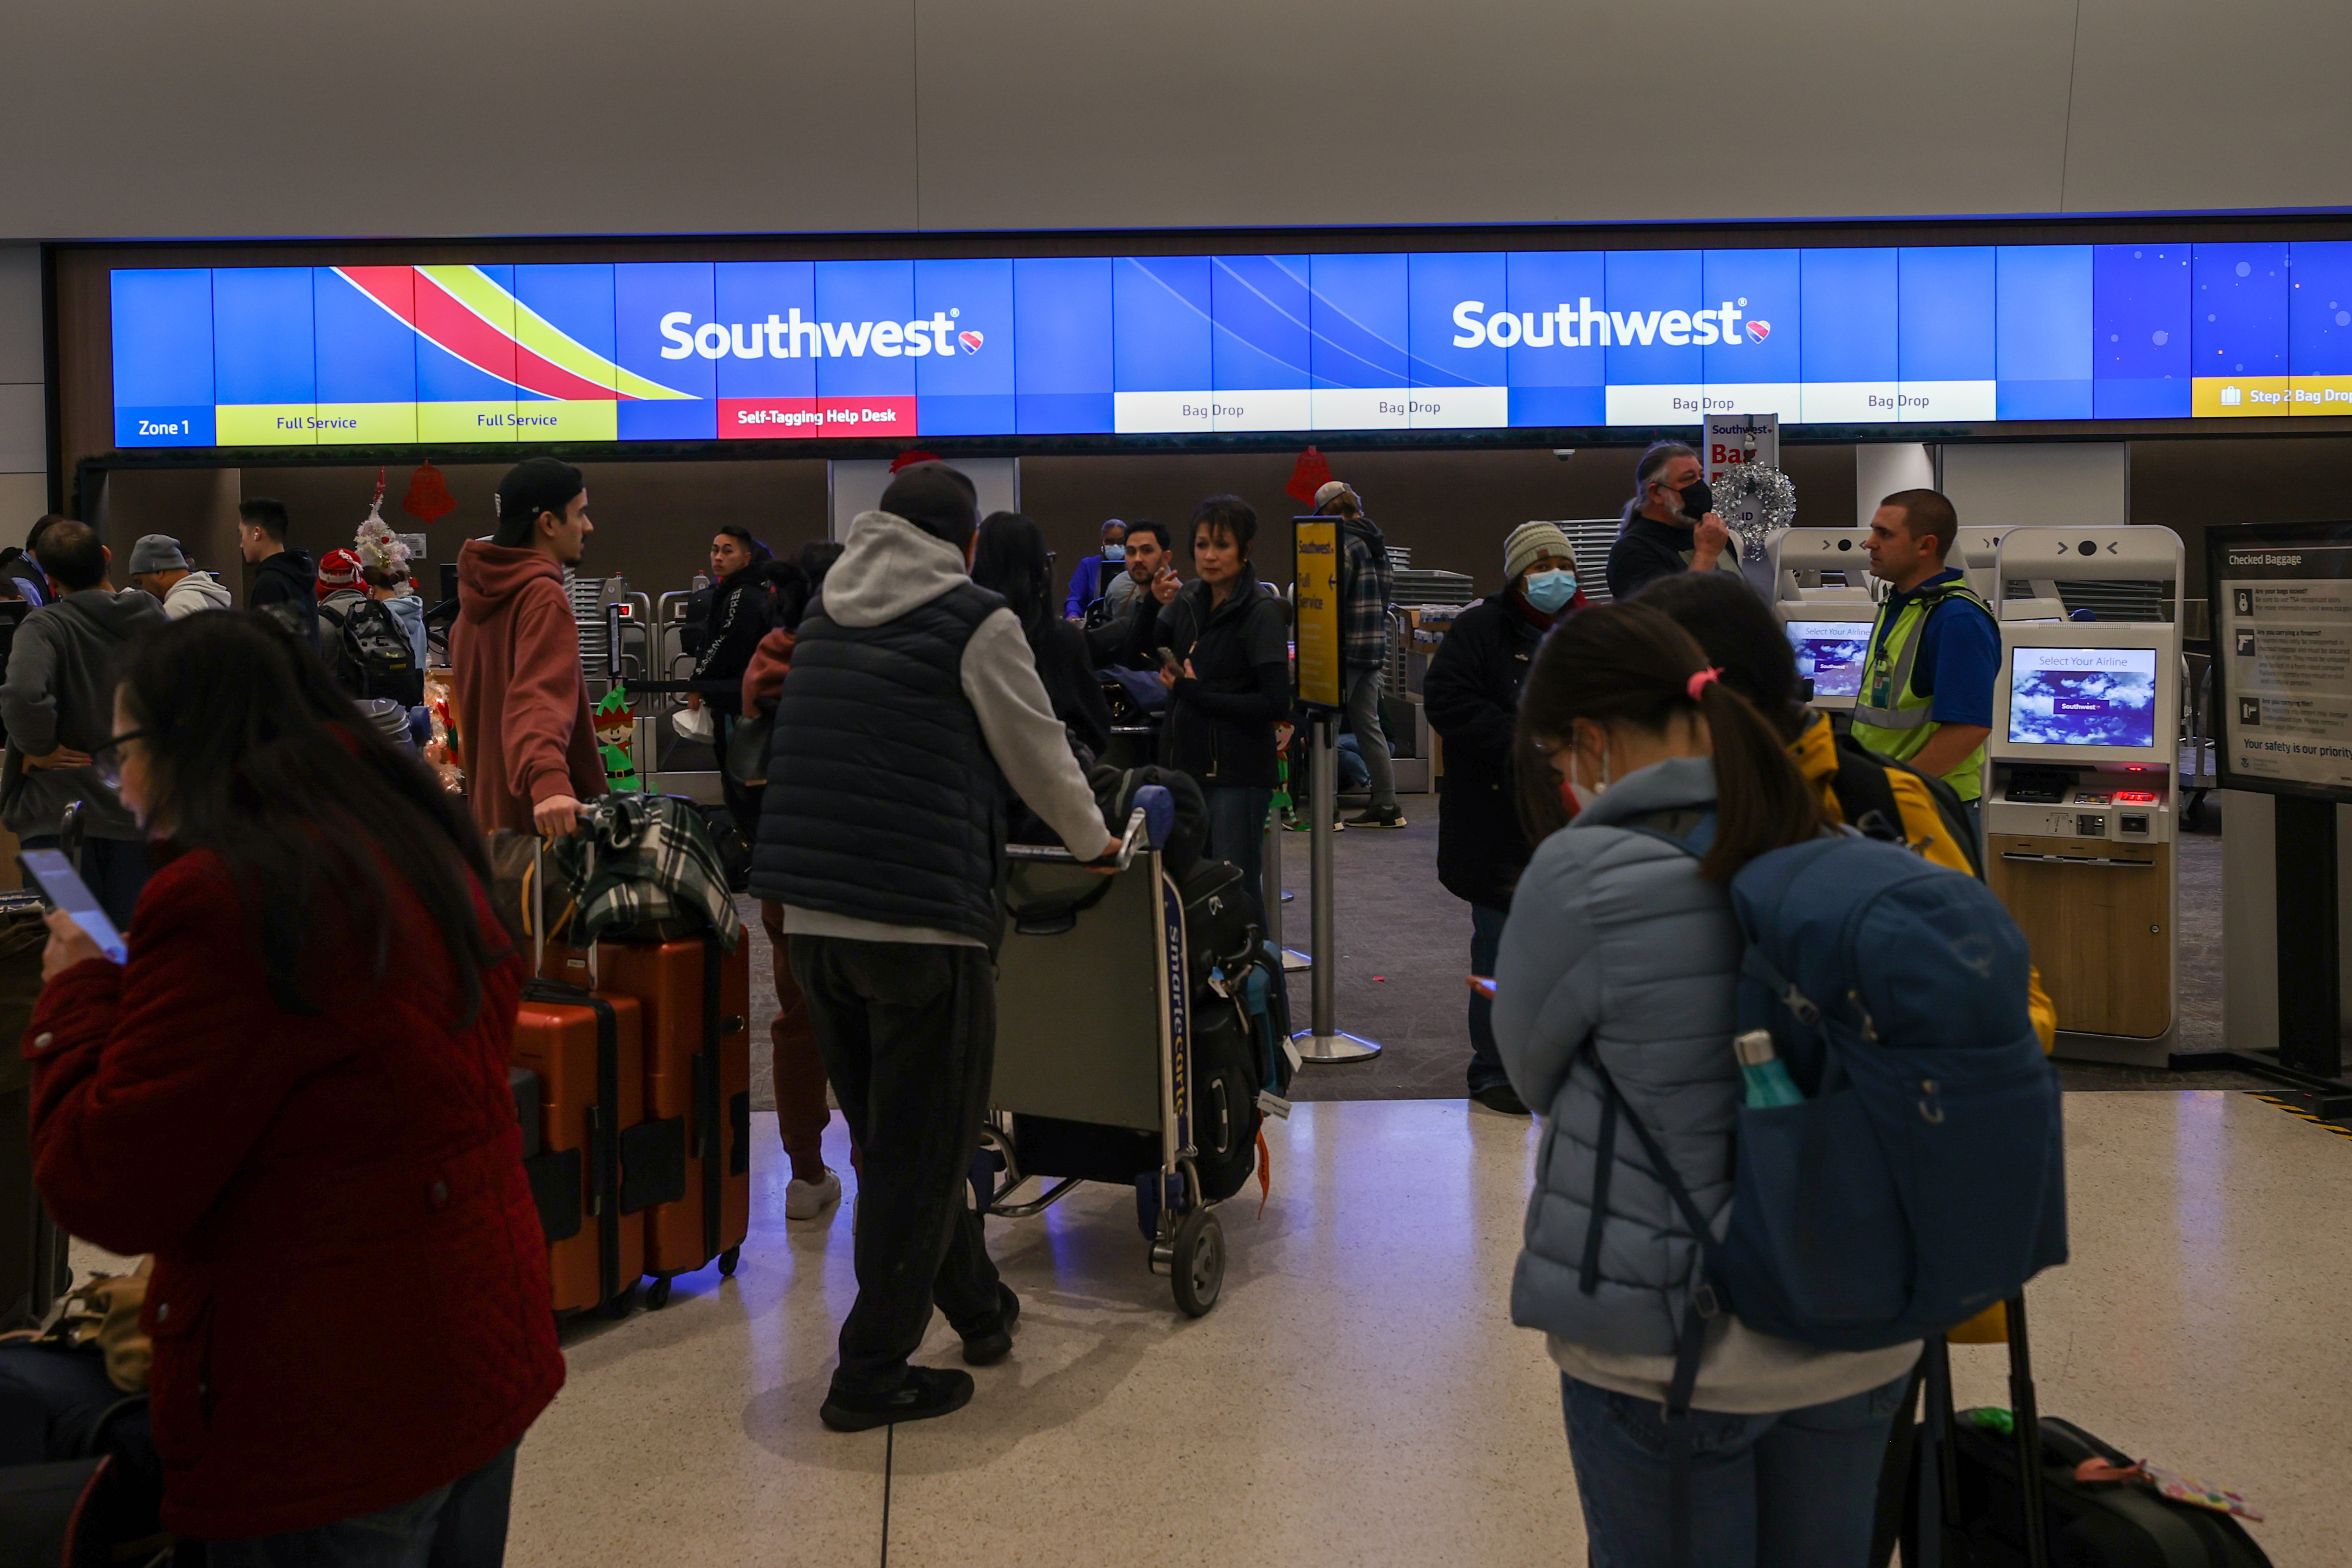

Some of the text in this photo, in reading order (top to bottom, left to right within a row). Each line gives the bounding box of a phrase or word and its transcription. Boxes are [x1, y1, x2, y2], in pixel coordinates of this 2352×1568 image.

[1673, 397, 1734, 412] Bag Drop
[1869, 395, 1930, 409] Bag Drop
[2250, 389, 2281, 405] Step
[2283, 389, 2292, 402] 2
[2295, 389, 2322, 404] Bag
[1183, 404, 1244, 419] Bag Drop
[1380, 401, 1441, 416] Bag Drop
[277, 416, 357, 429] Full Service
[477, 413, 558, 427] Full Service
[737, 408, 897, 426] Self-Tagging Help Desk
[139, 420, 189, 435] Zone 1
[2229, 554, 2302, 566] Checked Baggage
[2039, 656, 2128, 667] Select Your Airline
[2061, 702, 2096, 710] Southwest
[2244, 739, 2263, 749] Your
[2265, 741, 2291, 754] safety
[2293, 743, 2301, 753] is
[2302, 746, 2317, 755] our
